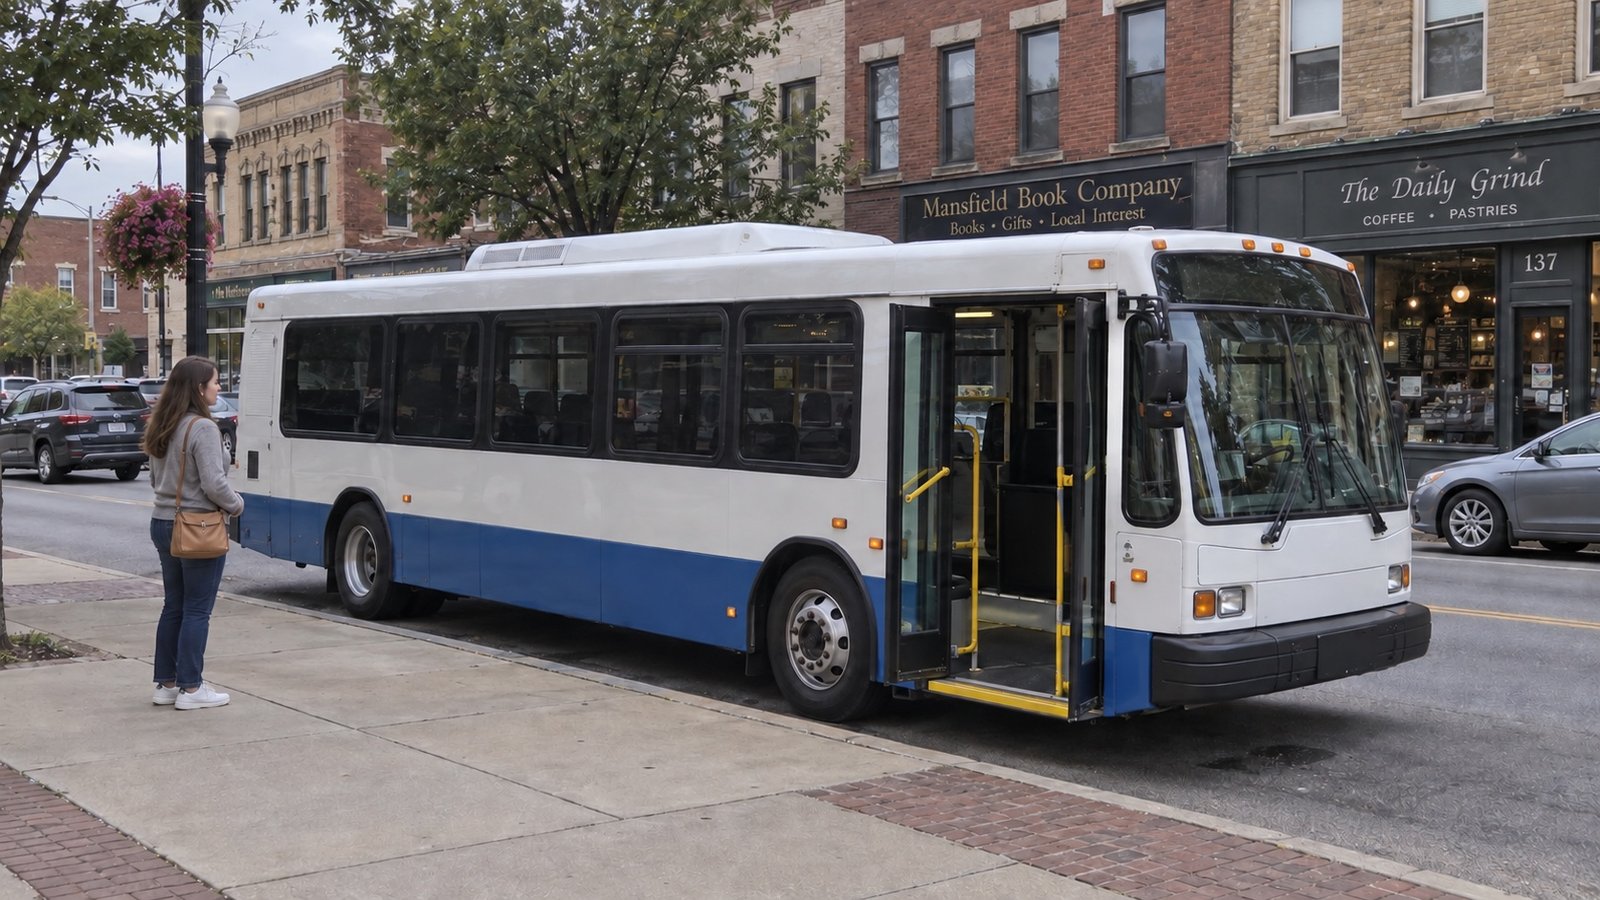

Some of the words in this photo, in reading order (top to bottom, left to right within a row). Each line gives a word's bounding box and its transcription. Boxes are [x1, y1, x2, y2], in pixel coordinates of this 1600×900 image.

[1340, 177, 1379, 204] The
[1392, 170, 1457, 204] Daily
[1471, 159, 1551, 199] Grind
[922, 190, 1008, 218] Mansfield
[1018, 183, 1068, 208] Book
[1078, 177, 1183, 204] Company
[950, 220, 985, 236] Books
[1002, 215, 1033, 231] Gifts
[1051, 209, 1086, 227] Local
[1093, 205, 1146, 223] Interest
[1363, 211, 1415, 226] COFFEE
[1450, 203, 1518, 219] PASTRIES
[1525, 253, 1558, 272] 137
